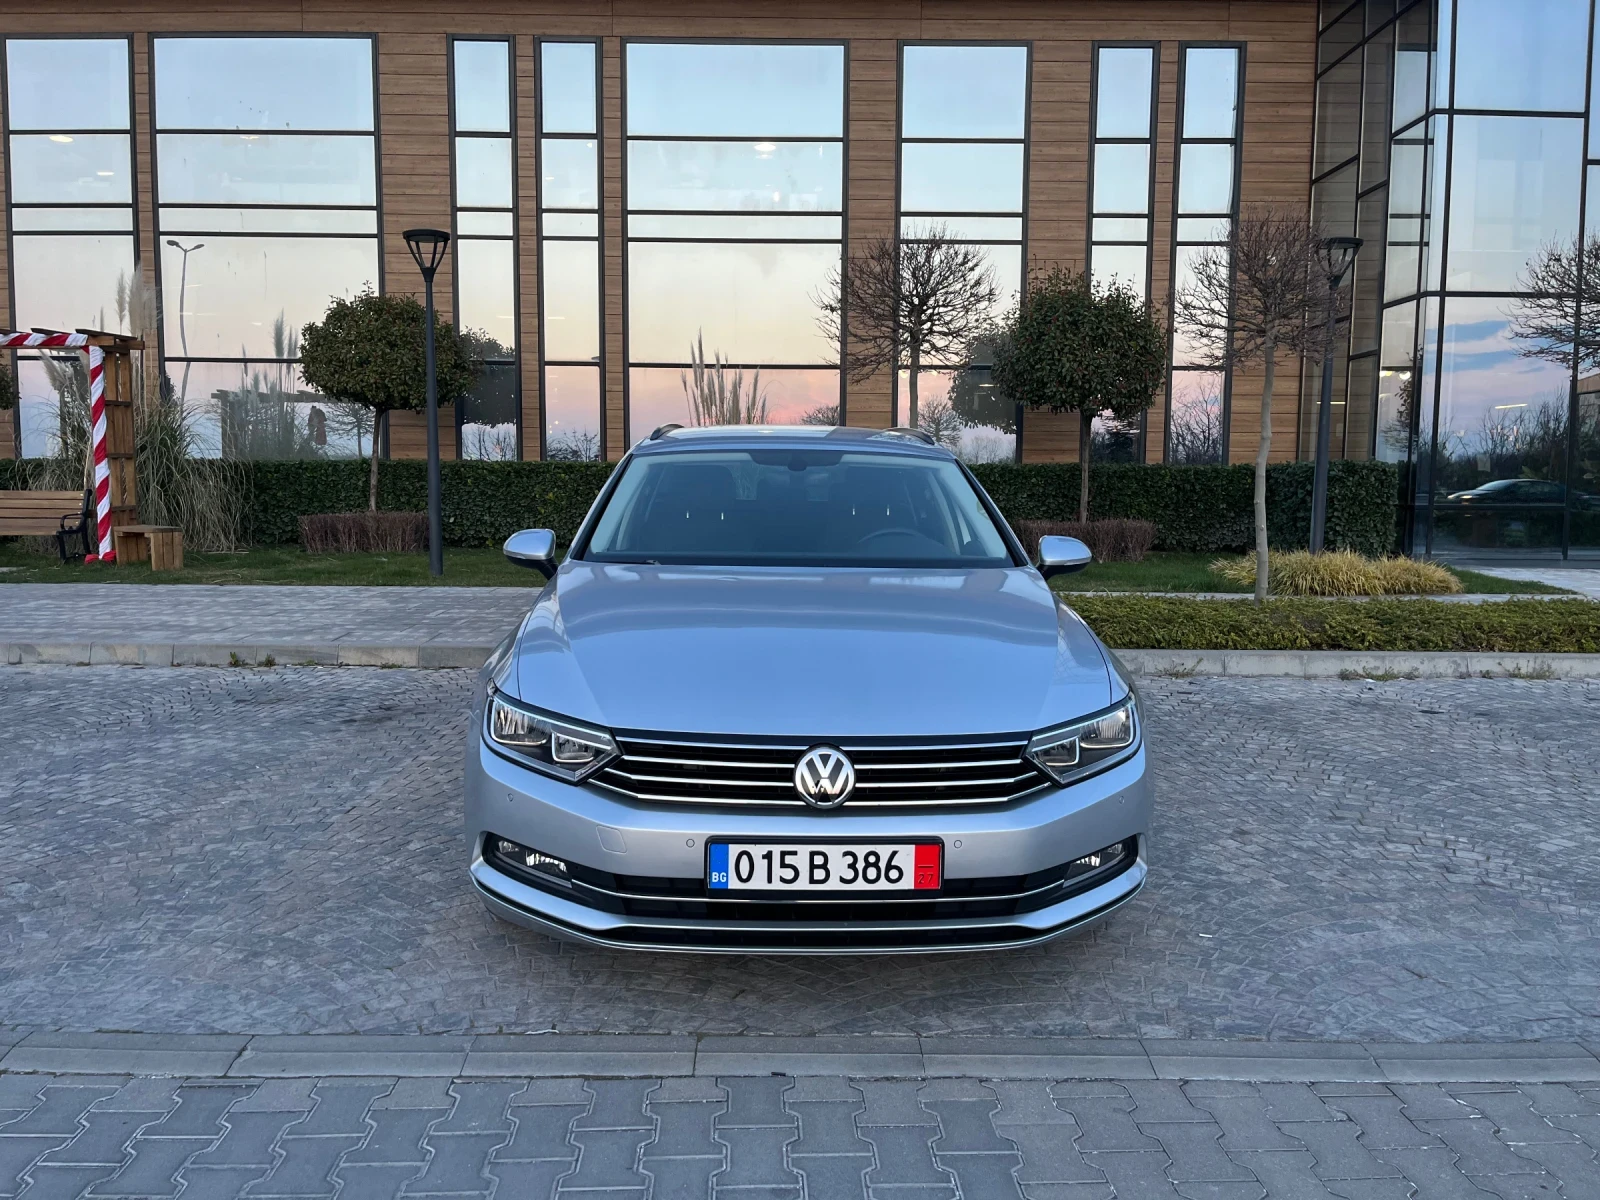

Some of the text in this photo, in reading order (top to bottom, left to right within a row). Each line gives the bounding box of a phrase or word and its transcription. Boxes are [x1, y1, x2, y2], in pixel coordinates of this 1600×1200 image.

[796, 749, 853, 806] VW
[711, 871, 727, 883] BG
[917, 872, 934, 885] 27
